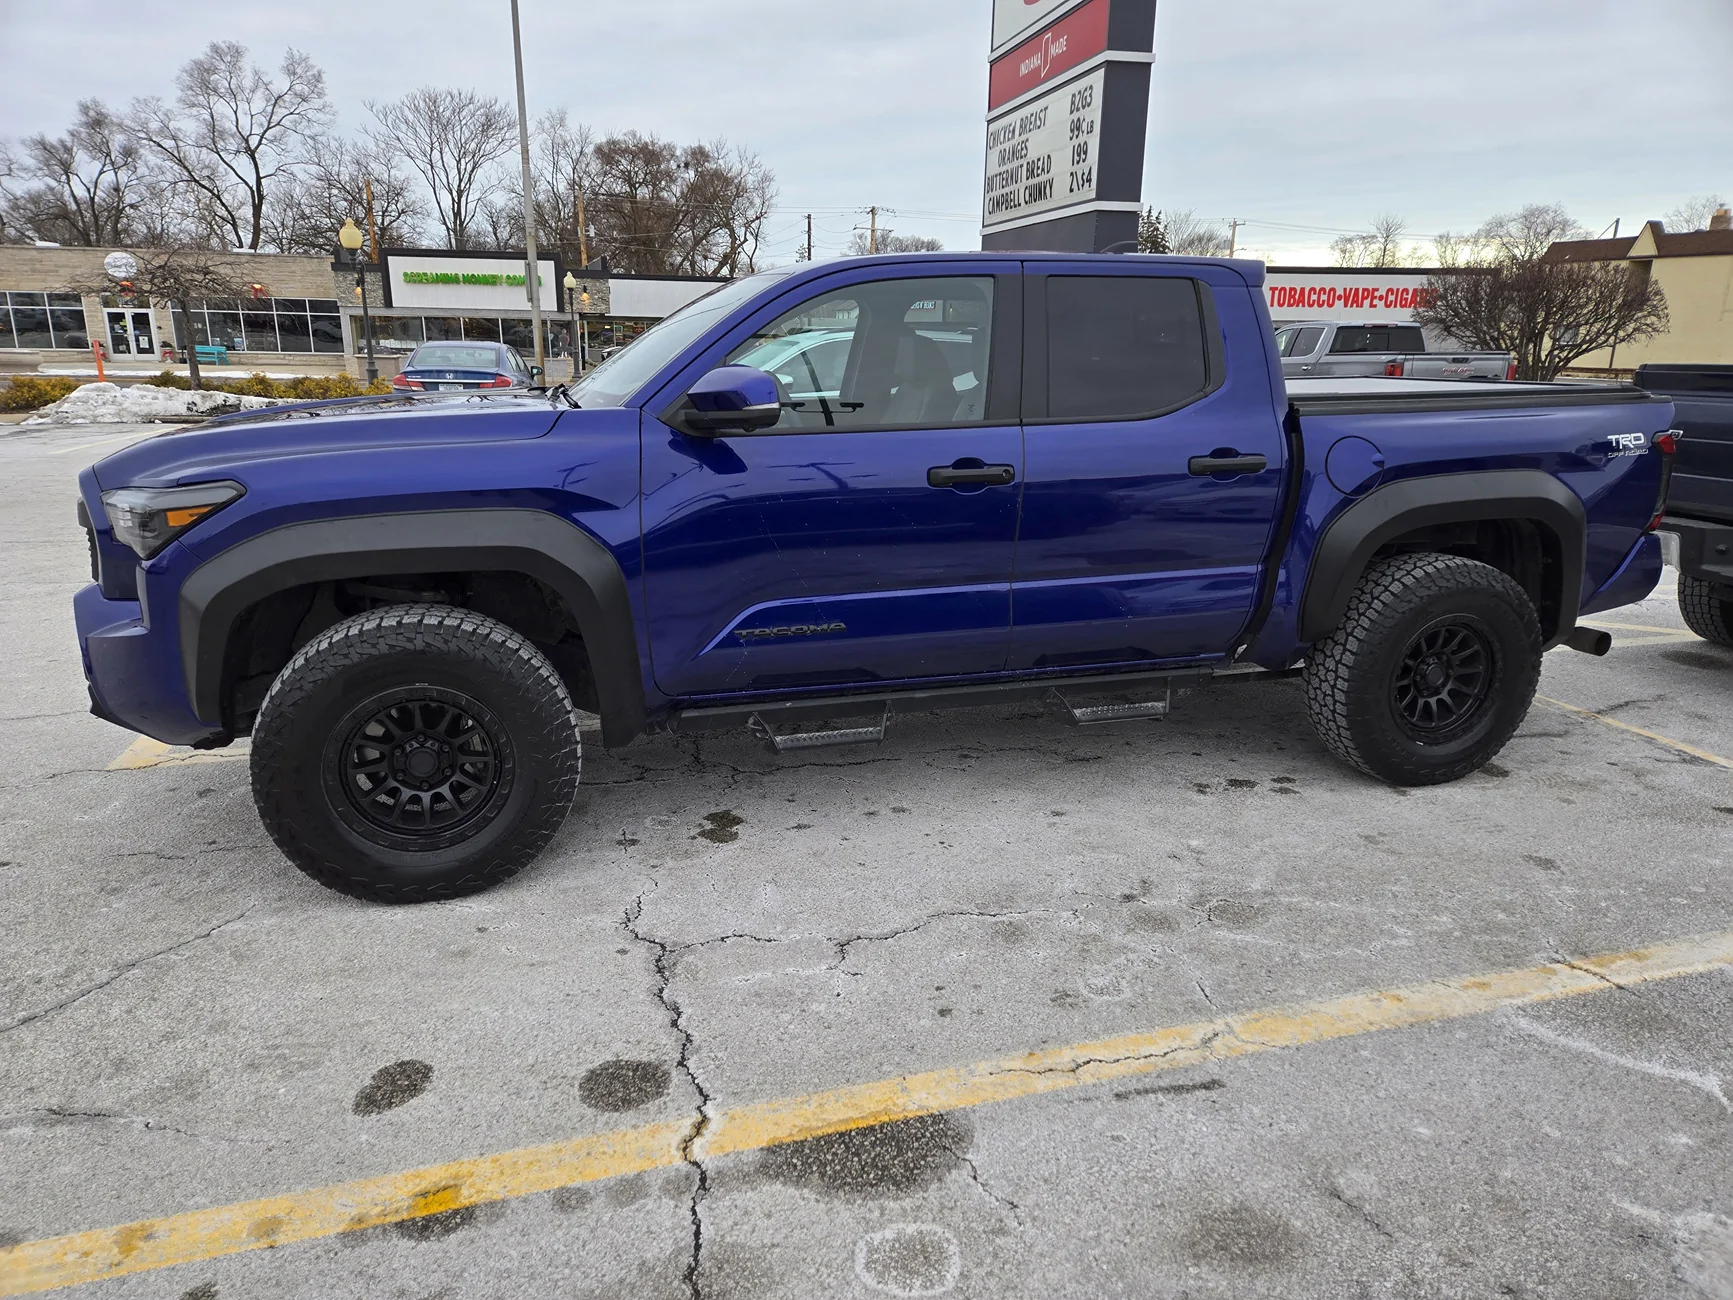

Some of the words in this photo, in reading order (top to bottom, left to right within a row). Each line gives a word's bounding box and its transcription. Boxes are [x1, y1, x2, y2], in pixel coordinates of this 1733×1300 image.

[1019, 52, 1041, 77] INDIANA
[1050, 35, 1068, 59] MADE
[989, 120, 1017, 150] CHICKEN
[1019, 105, 1049, 137] BREAST
[1069, 84, 1094, 115] B2G3
[998, 138, 1029, 168] ORANGES
[1086, 120, 1094, 135] LB
[987, 164, 1024, 194] BUTTERNUT
[1026, 153, 1052, 181] BREAD
[1071, 140, 1089, 166] 199
[987, 188, 1022, 215] CAMPBELL
[1023, 177, 1054, 205] CHUNKY
[402, 271, 461, 285] SCREAMING
[461, 273, 504, 286] MONKEY
[505, 274, 543, 287] COMS
[1269, 286, 1336, 309] TOBACCO
[1342, 287, 1380, 309] VAPE
[1607, 432, 1645, 449] TRD
[735, 622, 847, 639] TACOMA
